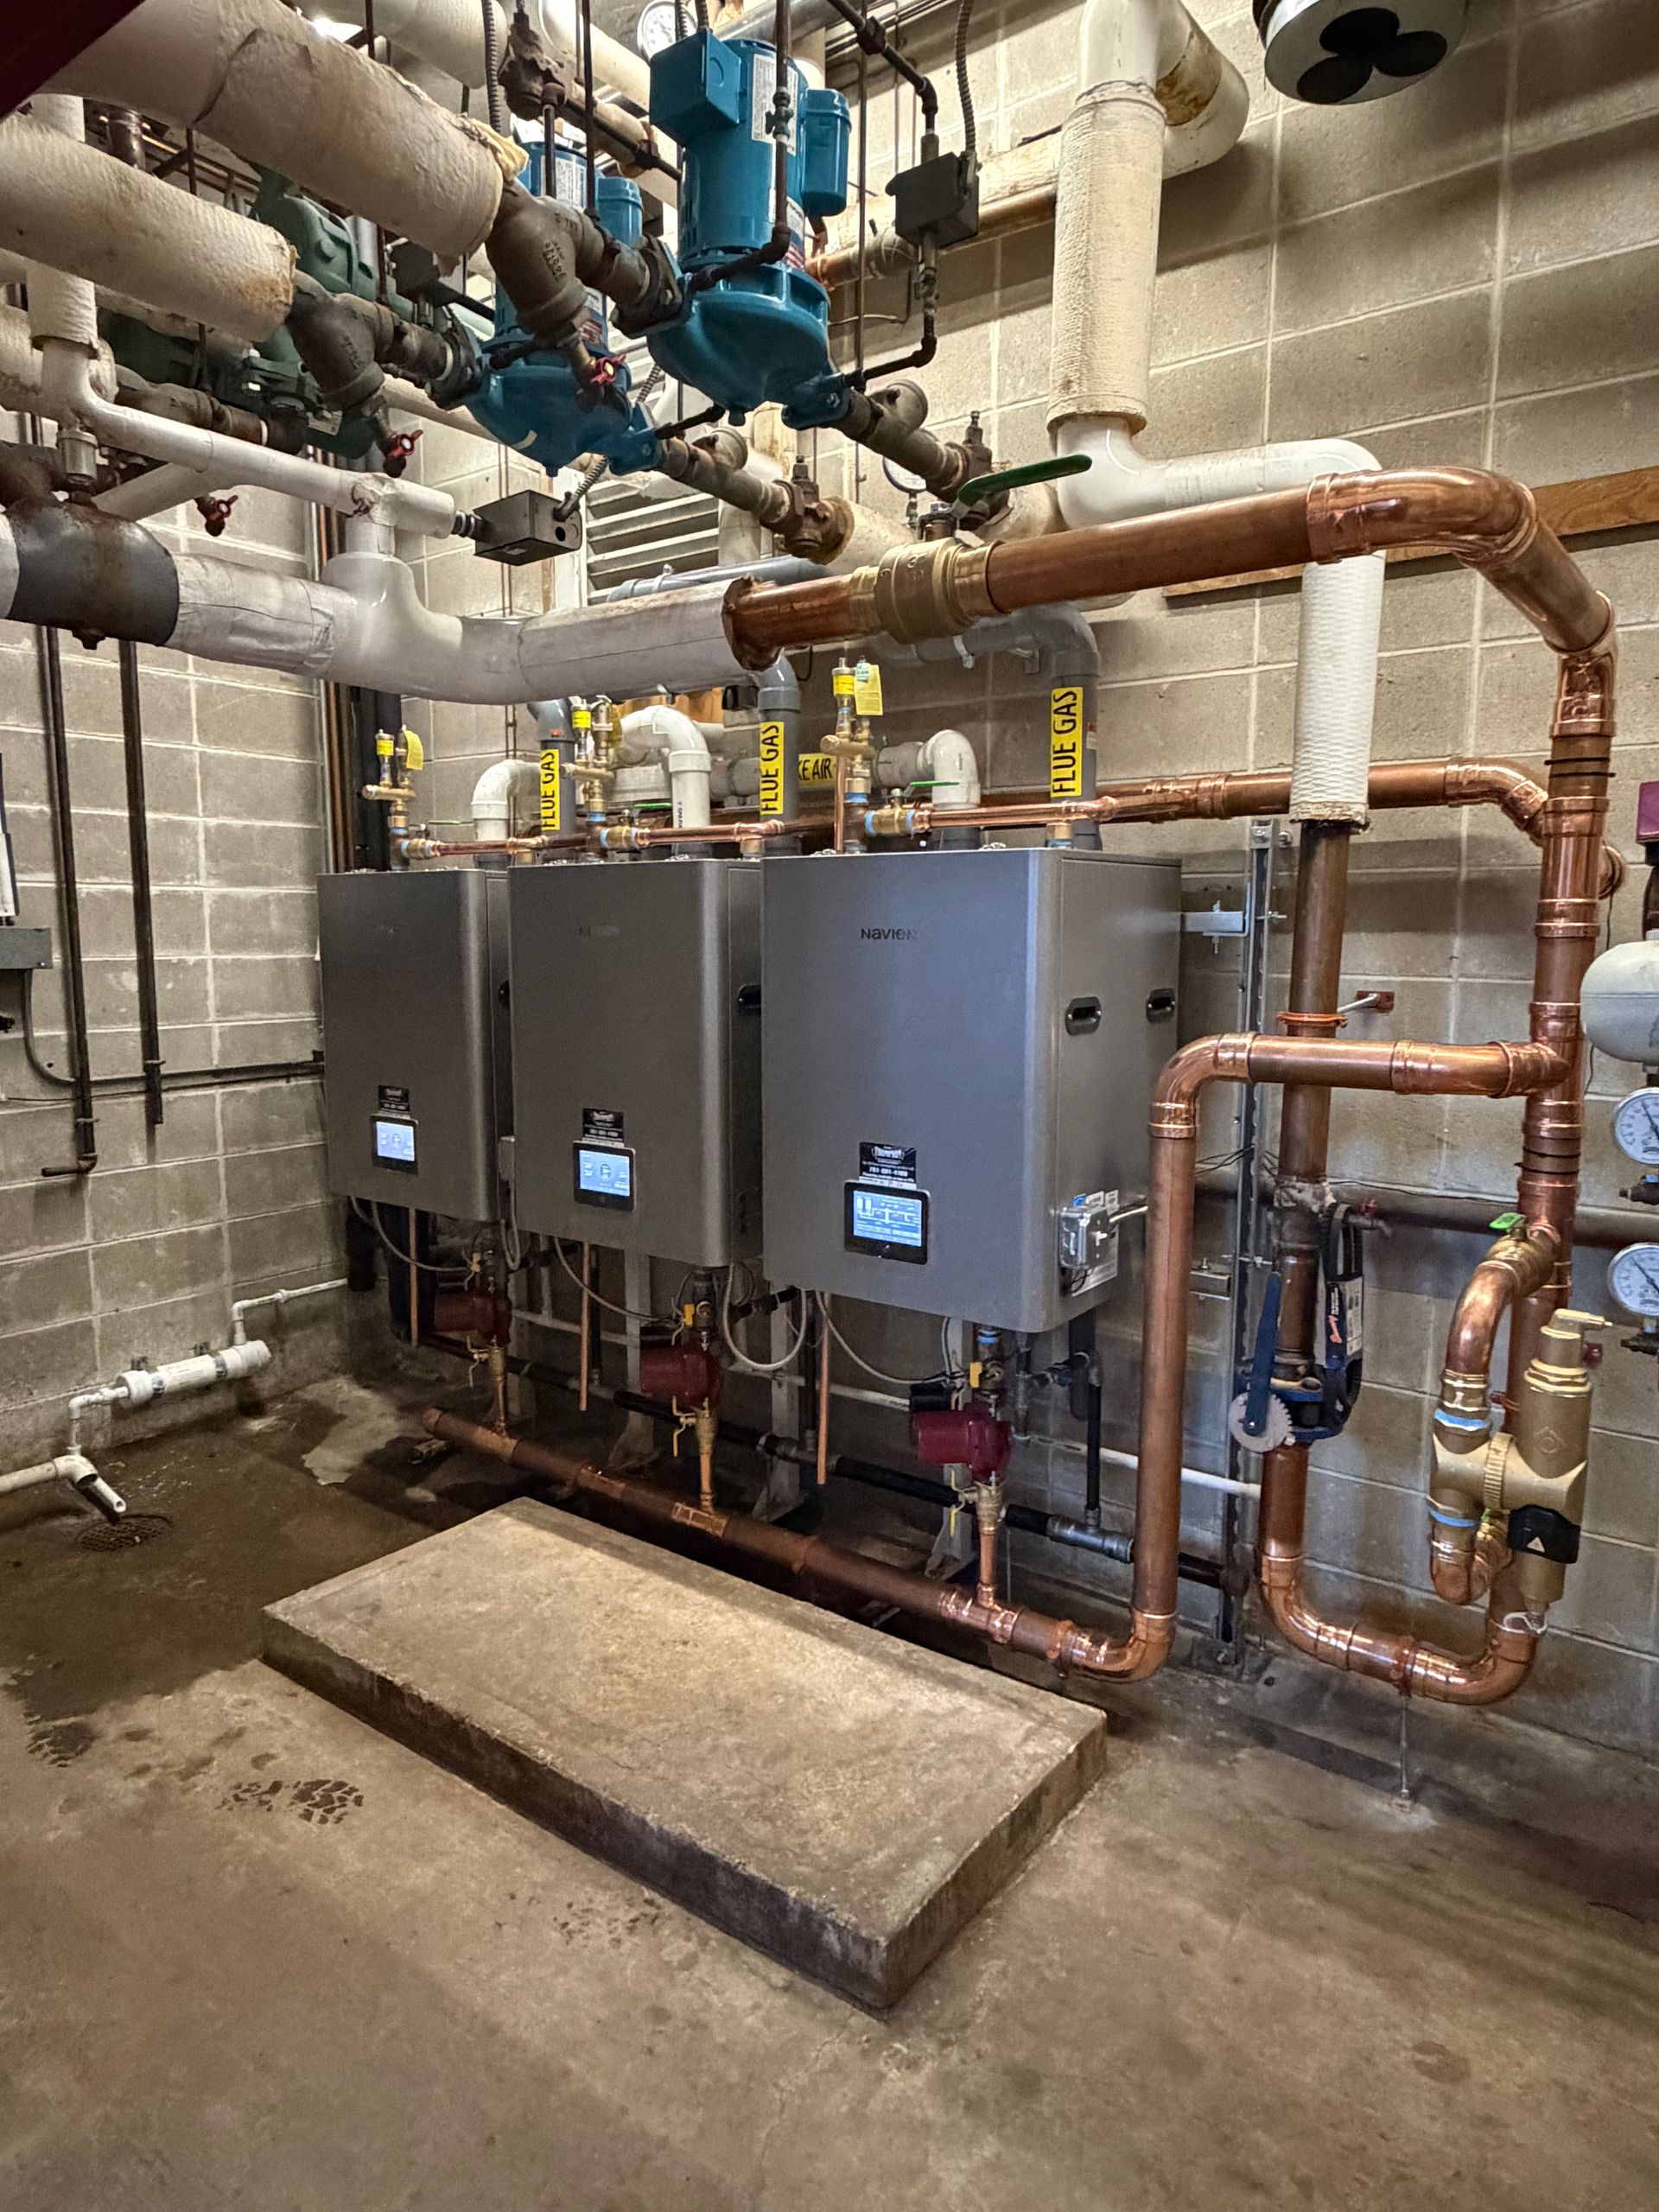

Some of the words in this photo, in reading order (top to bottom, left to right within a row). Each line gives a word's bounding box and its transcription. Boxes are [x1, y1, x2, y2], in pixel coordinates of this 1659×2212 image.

[1052, 690, 1077, 735] GAS
[761, 725, 779, 762] GAS
[541, 752, 555, 785] GAS
[812, 758, 833, 780] AIR
[1052, 741, 1076, 793] FLUE
[761, 768, 779, 811] FLUE
[541, 790, 556, 828] FLUE
